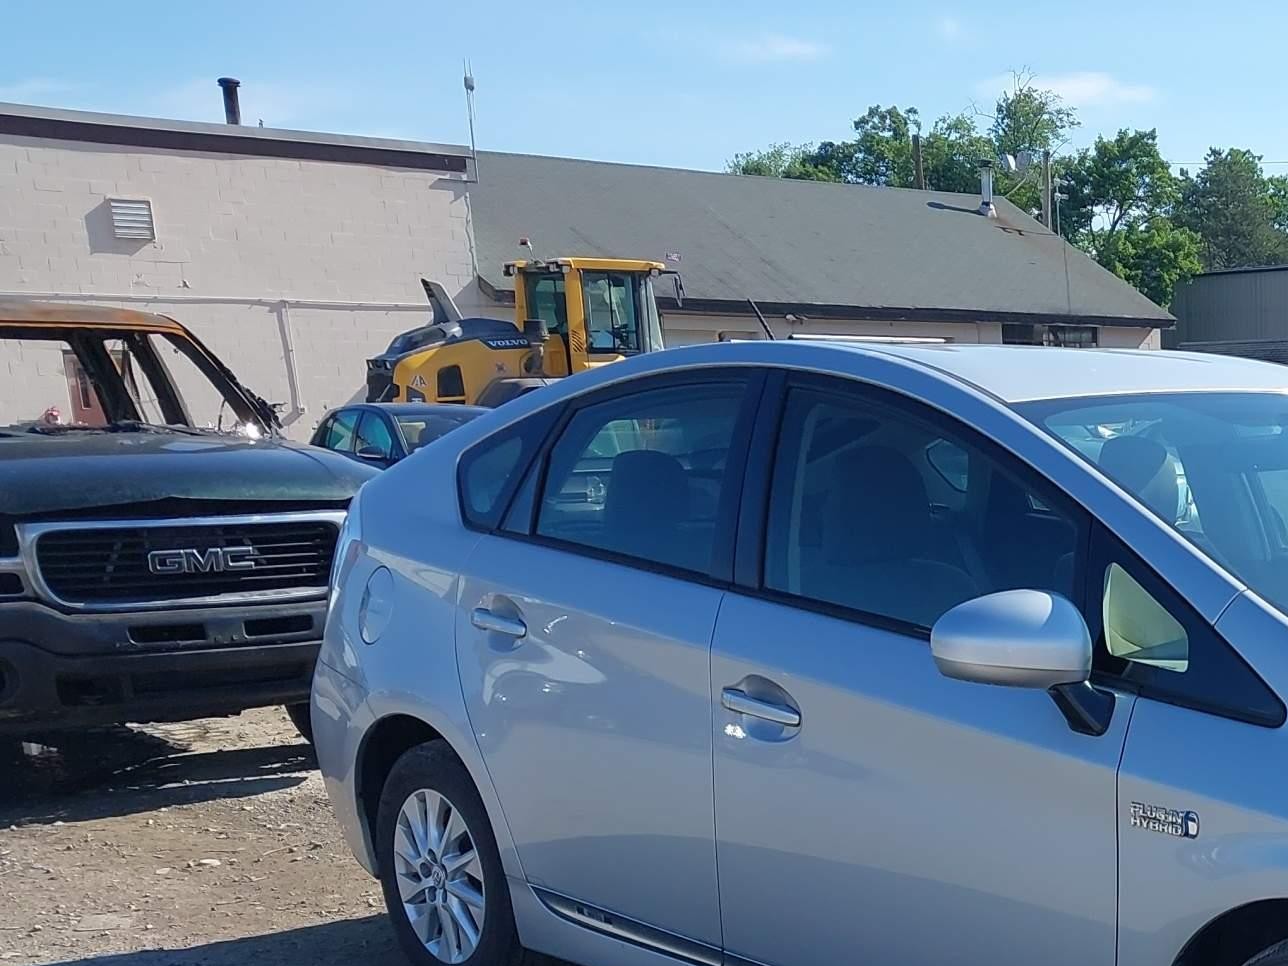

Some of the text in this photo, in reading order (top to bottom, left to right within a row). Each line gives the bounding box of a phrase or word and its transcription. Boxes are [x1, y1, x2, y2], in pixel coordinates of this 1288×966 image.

[488, 339, 528, 347] VOLVO
[147, 545, 256, 575] GMC
[1130, 816, 1184, 837] HYBRID
